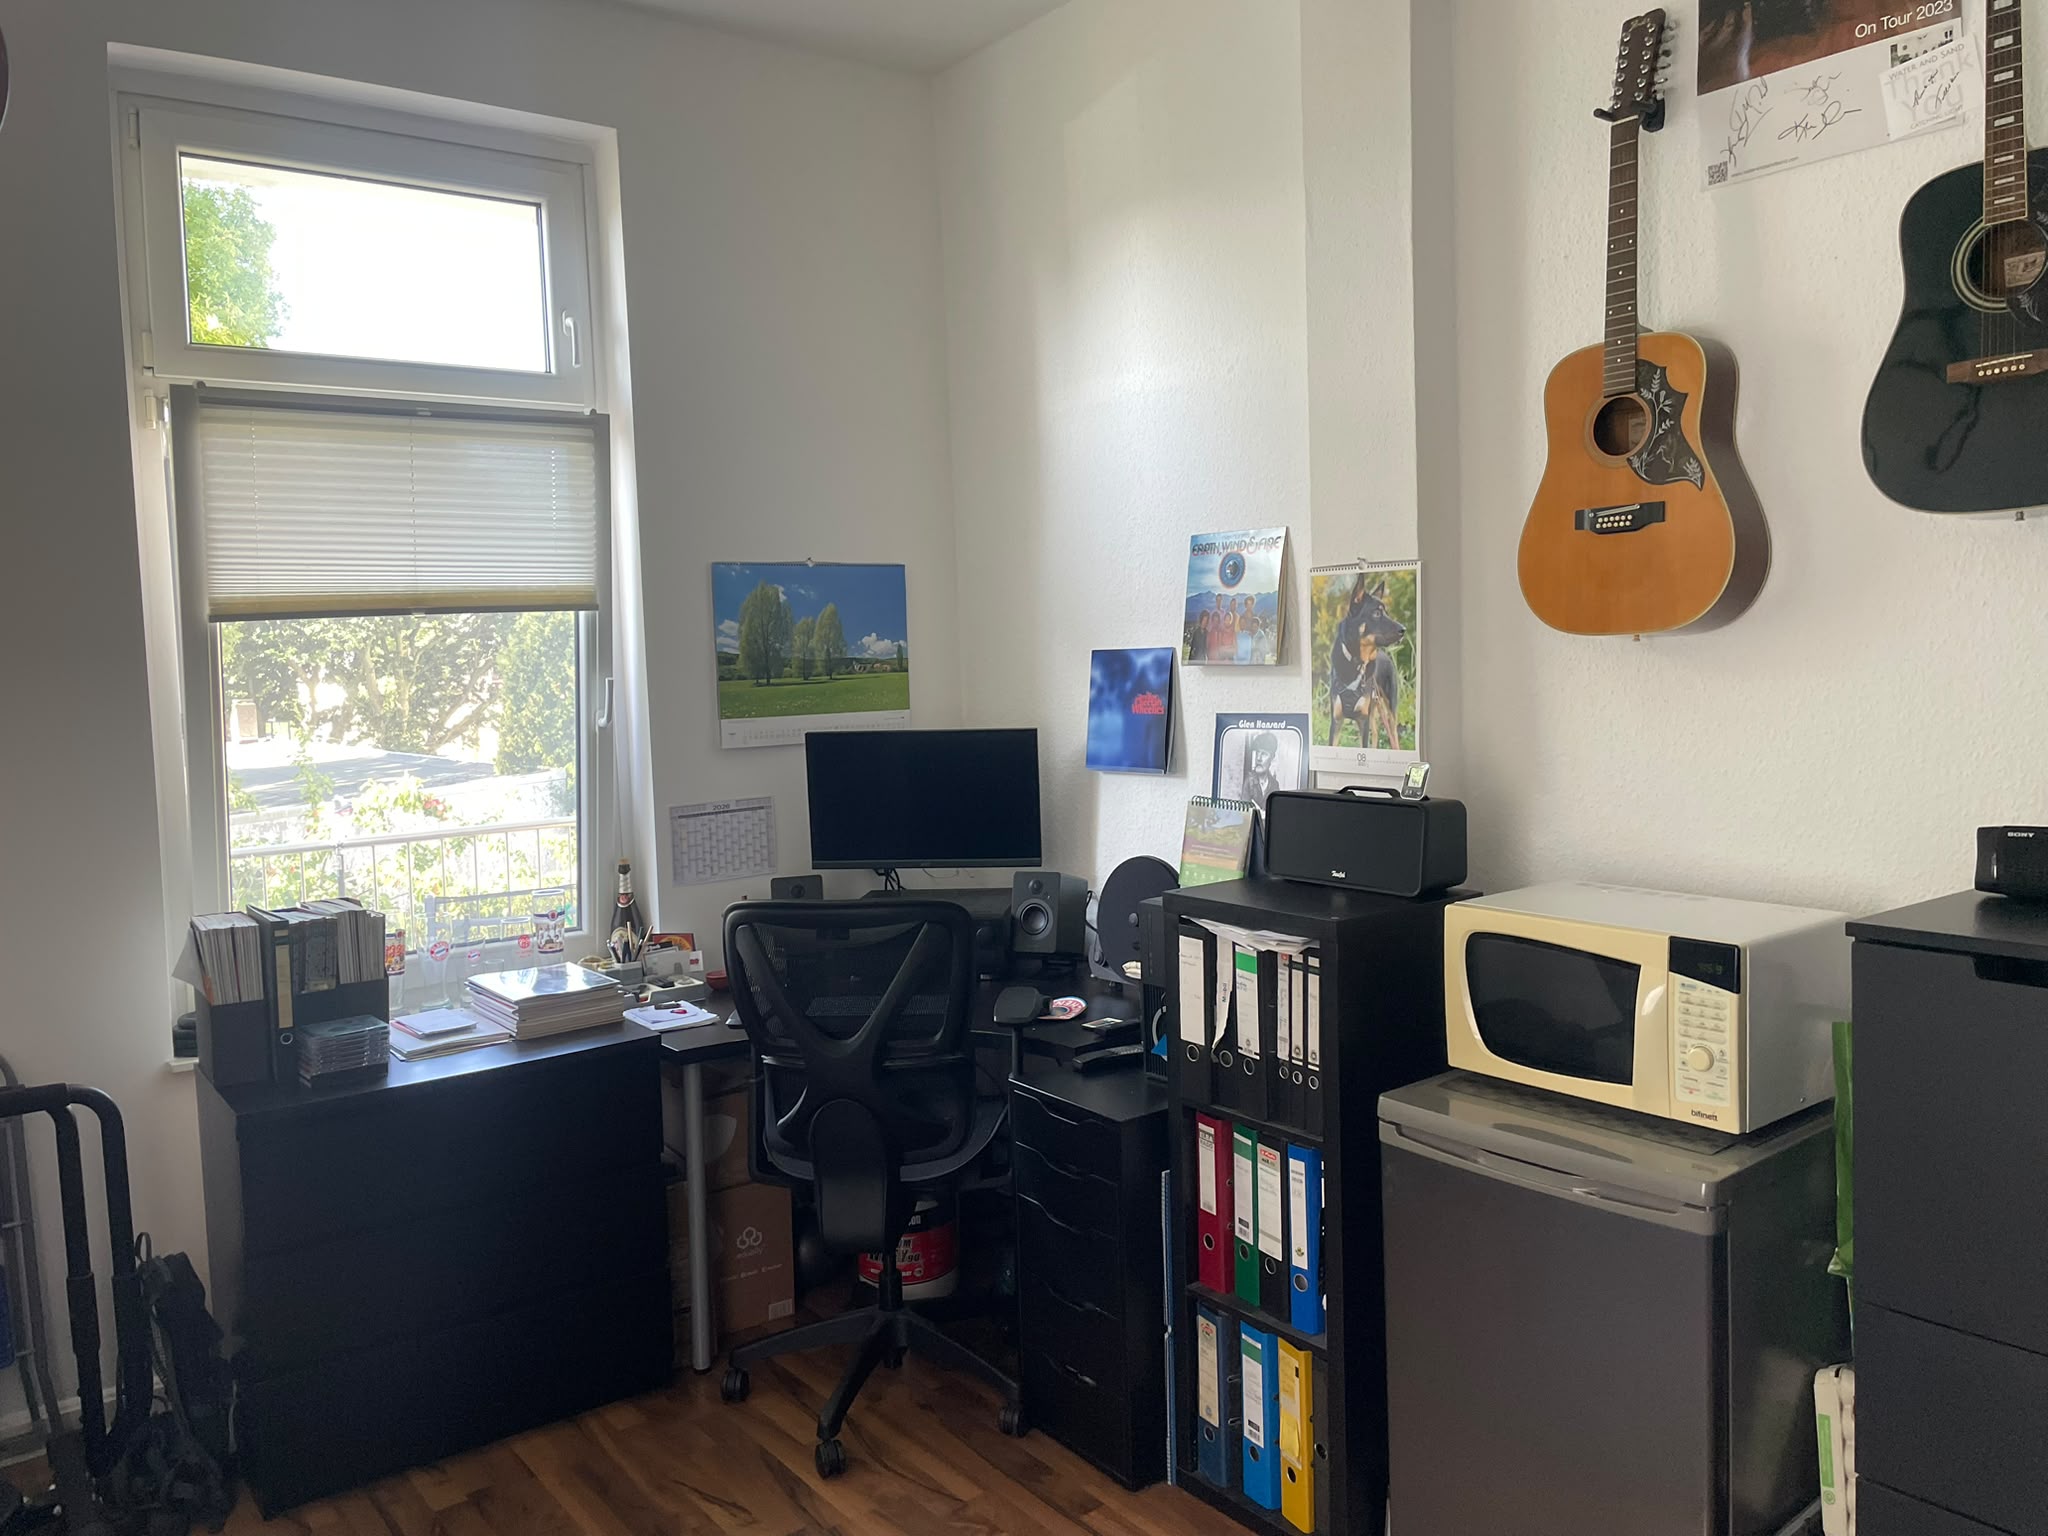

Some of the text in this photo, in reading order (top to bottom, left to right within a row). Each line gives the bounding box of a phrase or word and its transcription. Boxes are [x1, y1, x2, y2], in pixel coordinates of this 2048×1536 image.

[1855, 0, 1954, 38] On Tour 2023
[1889, 43, 1965, 80] WATER AND SAND
[1238, 719, 1286, 729] Glen Hansard
